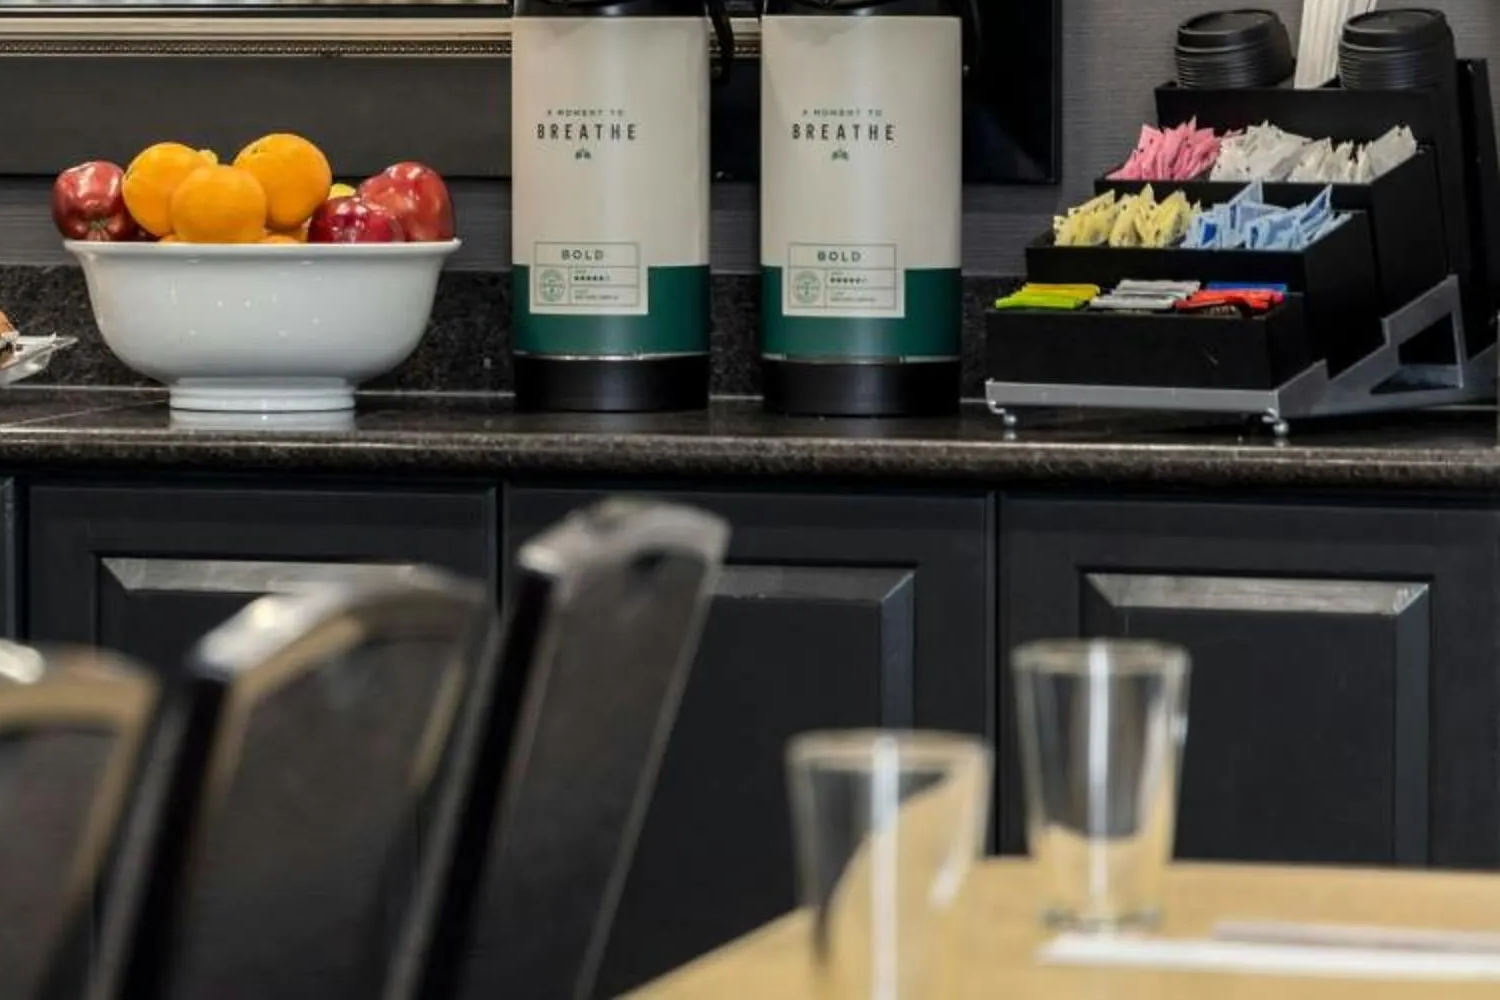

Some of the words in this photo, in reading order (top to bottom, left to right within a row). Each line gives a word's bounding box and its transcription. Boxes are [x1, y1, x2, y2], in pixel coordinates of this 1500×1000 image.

[537, 123, 637, 140] BREATHE
[792, 123, 895, 141] BREATHE
[561, 249, 604, 261] BOLD
[817, 250, 862, 262] BOLD
